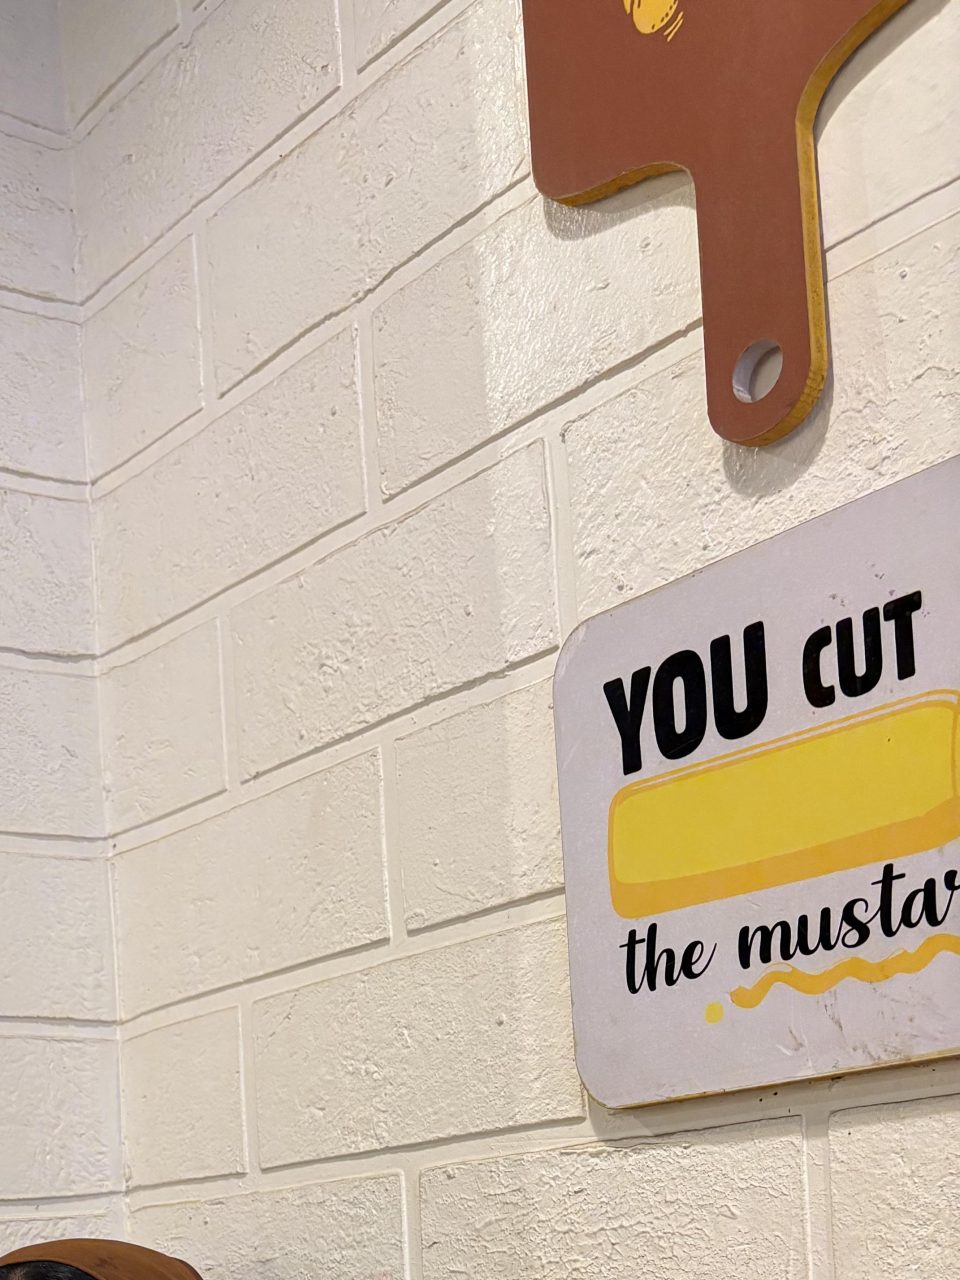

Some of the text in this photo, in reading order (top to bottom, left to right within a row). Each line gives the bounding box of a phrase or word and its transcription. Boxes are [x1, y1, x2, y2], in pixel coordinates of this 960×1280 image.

[602, 590, 923, 776] YOU CUT
[619, 923, 718, 995] the
